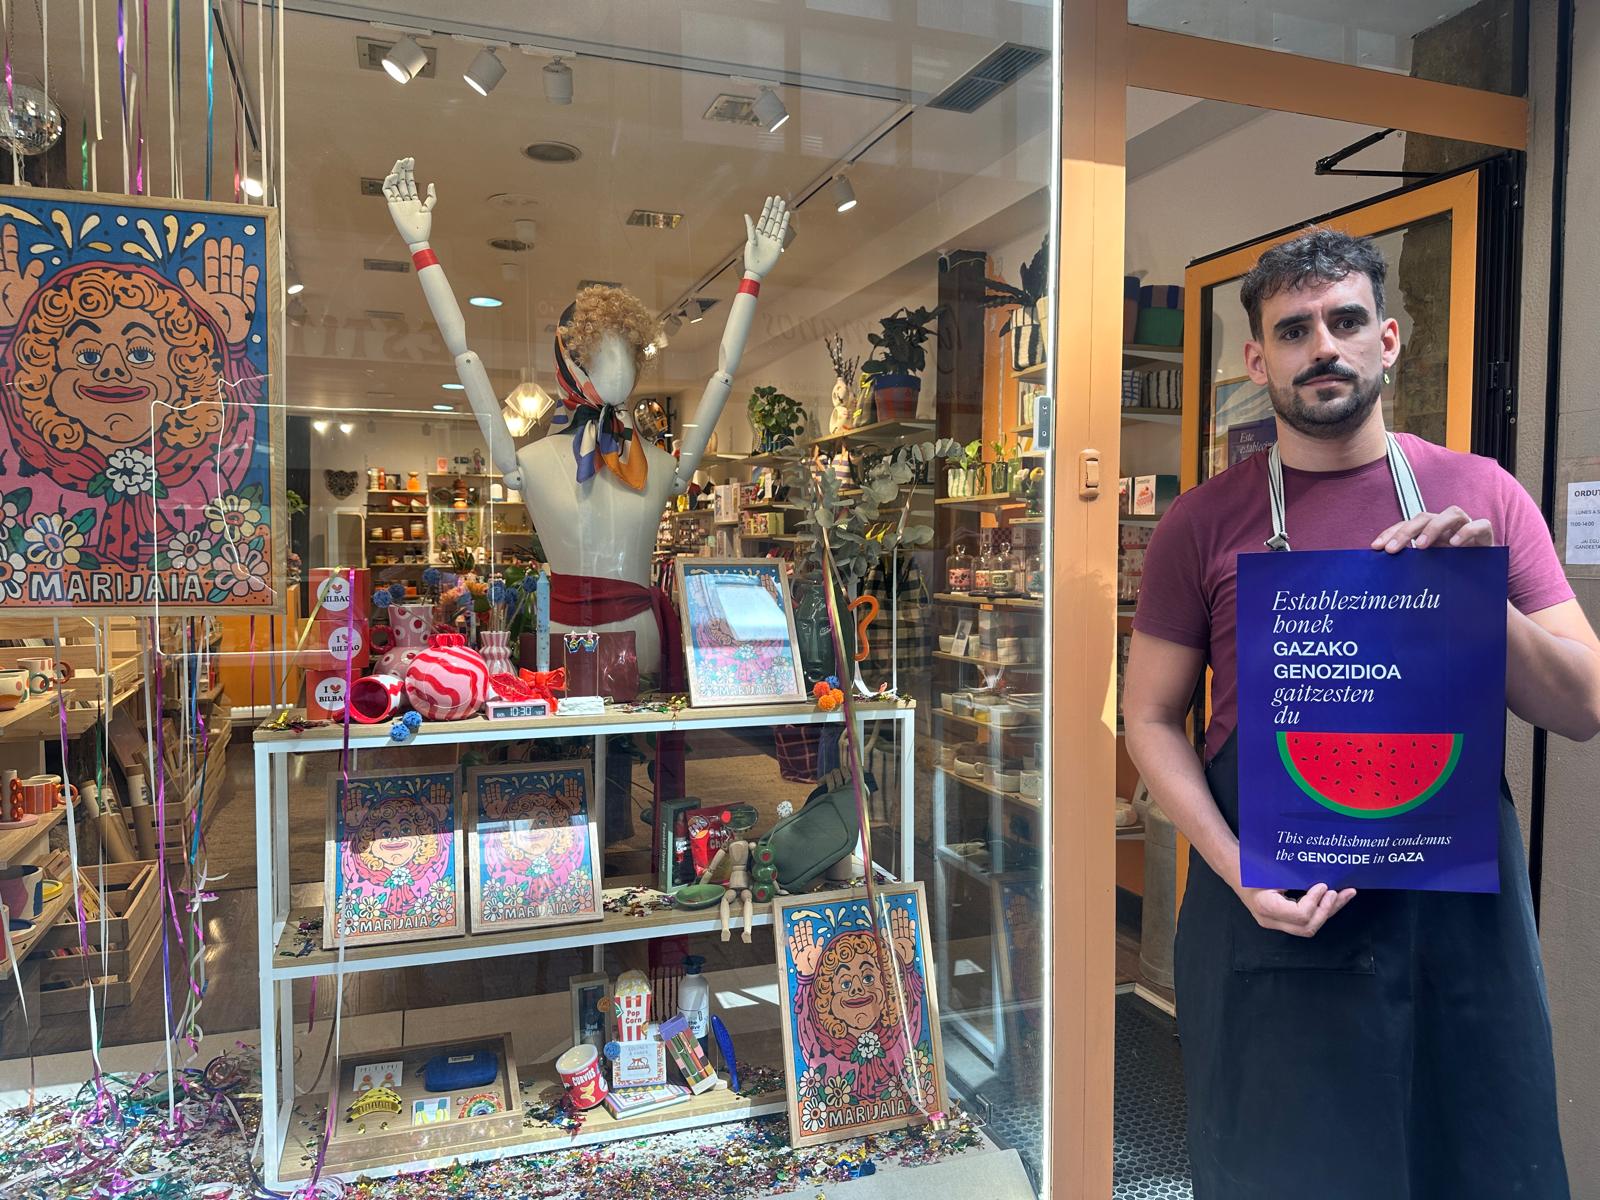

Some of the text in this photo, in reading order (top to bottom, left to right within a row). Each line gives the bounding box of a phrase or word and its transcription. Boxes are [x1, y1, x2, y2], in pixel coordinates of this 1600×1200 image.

[28, 570, 205, 602] MARIJAIA
[1272, 589, 1440, 612] Establezimendu
[1273, 641, 1358, 656] GAZAKO
[1273, 663, 1402, 680] GENOZIDIOA
[1271, 684, 1375, 707] gaitzesten
[510, 706, 532, 716] 10:30
[1274, 705, 1300, 725] du
[1276, 830, 1452, 847] This establishment condemns
[1275, 848, 1424, 865] the GENOCIDE in GAZA
[360, 916, 428, 933] MARIJAIA
[625, 1016, 642, 1024] Corn
[571, 1068, 596, 1086] CURVIES
[829, 1099, 907, 1127] MARIJAIA
